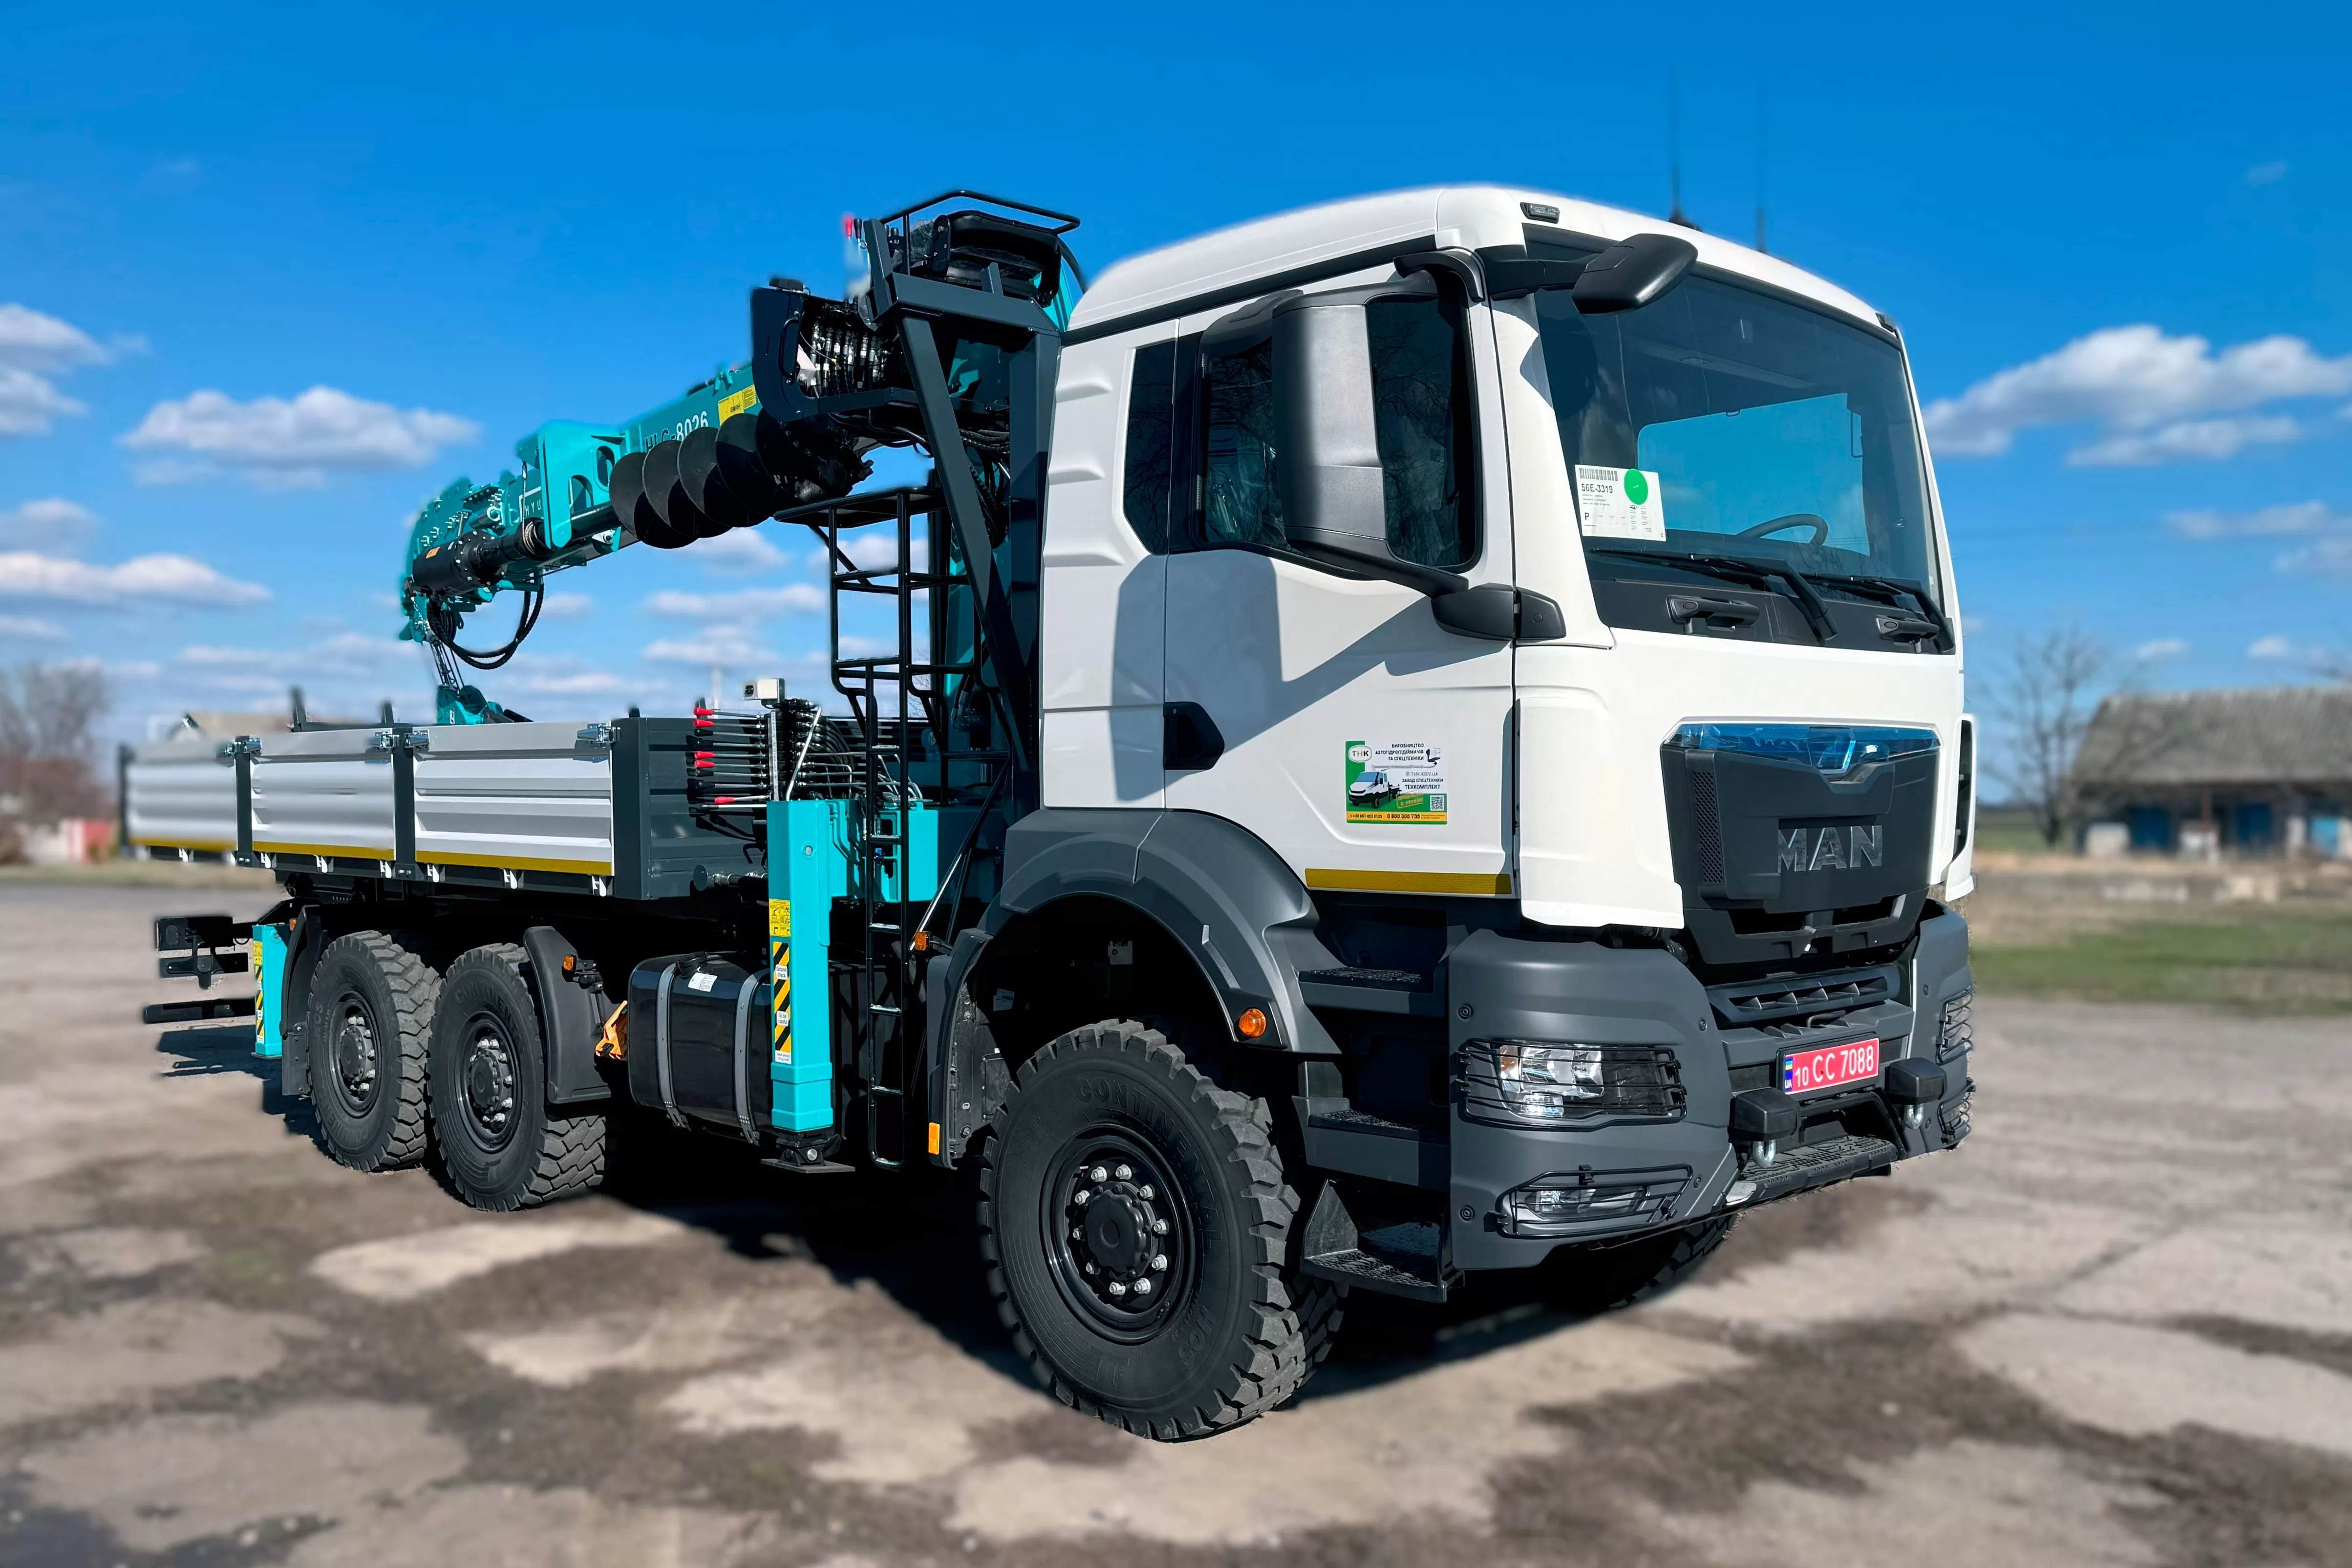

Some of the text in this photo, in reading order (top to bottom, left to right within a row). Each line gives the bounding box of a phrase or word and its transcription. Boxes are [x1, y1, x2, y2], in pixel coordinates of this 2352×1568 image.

[1581, 483, 1613, 494] 56E-3319
[1584, 512, 1589, 520] P
[1777, 825, 1882, 873] MAN
[1795, 1045, 1874, 1087] 10 CC 7088
[1785, 1079, 1793, 1088] UA
